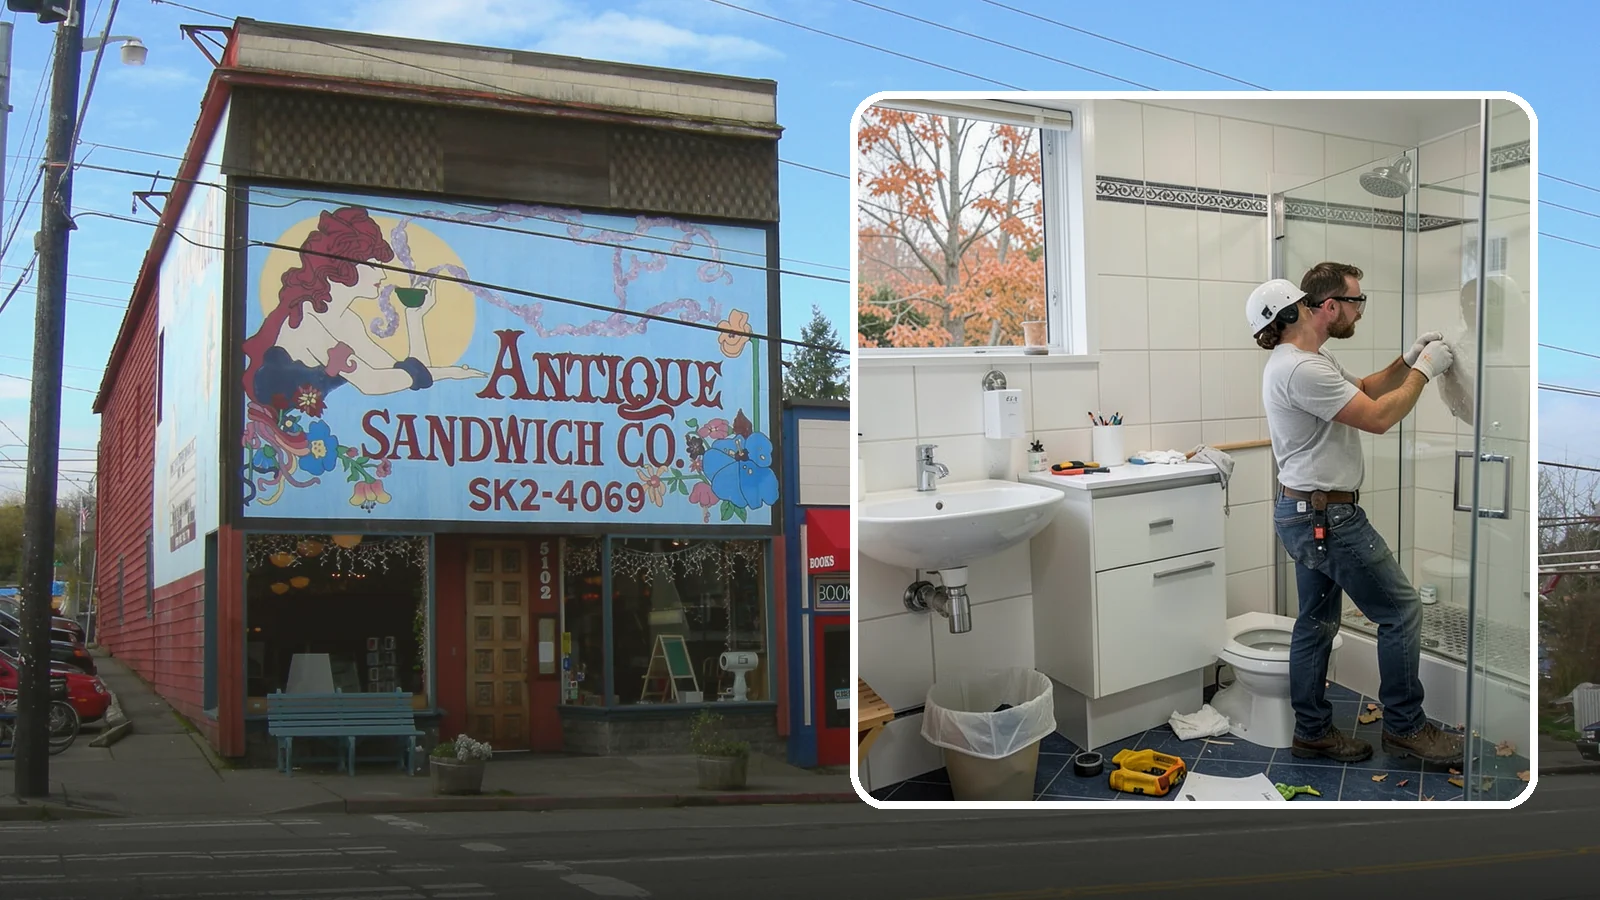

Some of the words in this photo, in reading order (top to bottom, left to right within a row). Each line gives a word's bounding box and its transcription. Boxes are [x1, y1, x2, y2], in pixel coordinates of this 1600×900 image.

[476, 329, 724, 421] ANTIQUE
[362, 408, 604, 467] SANDWICH
[618, 421, 684, 469] CO.
[468, 477, 646, 513] SK2-4069
[539, 542, 551, 600] 5102
[809, 555, 835, 569] BOOKS
